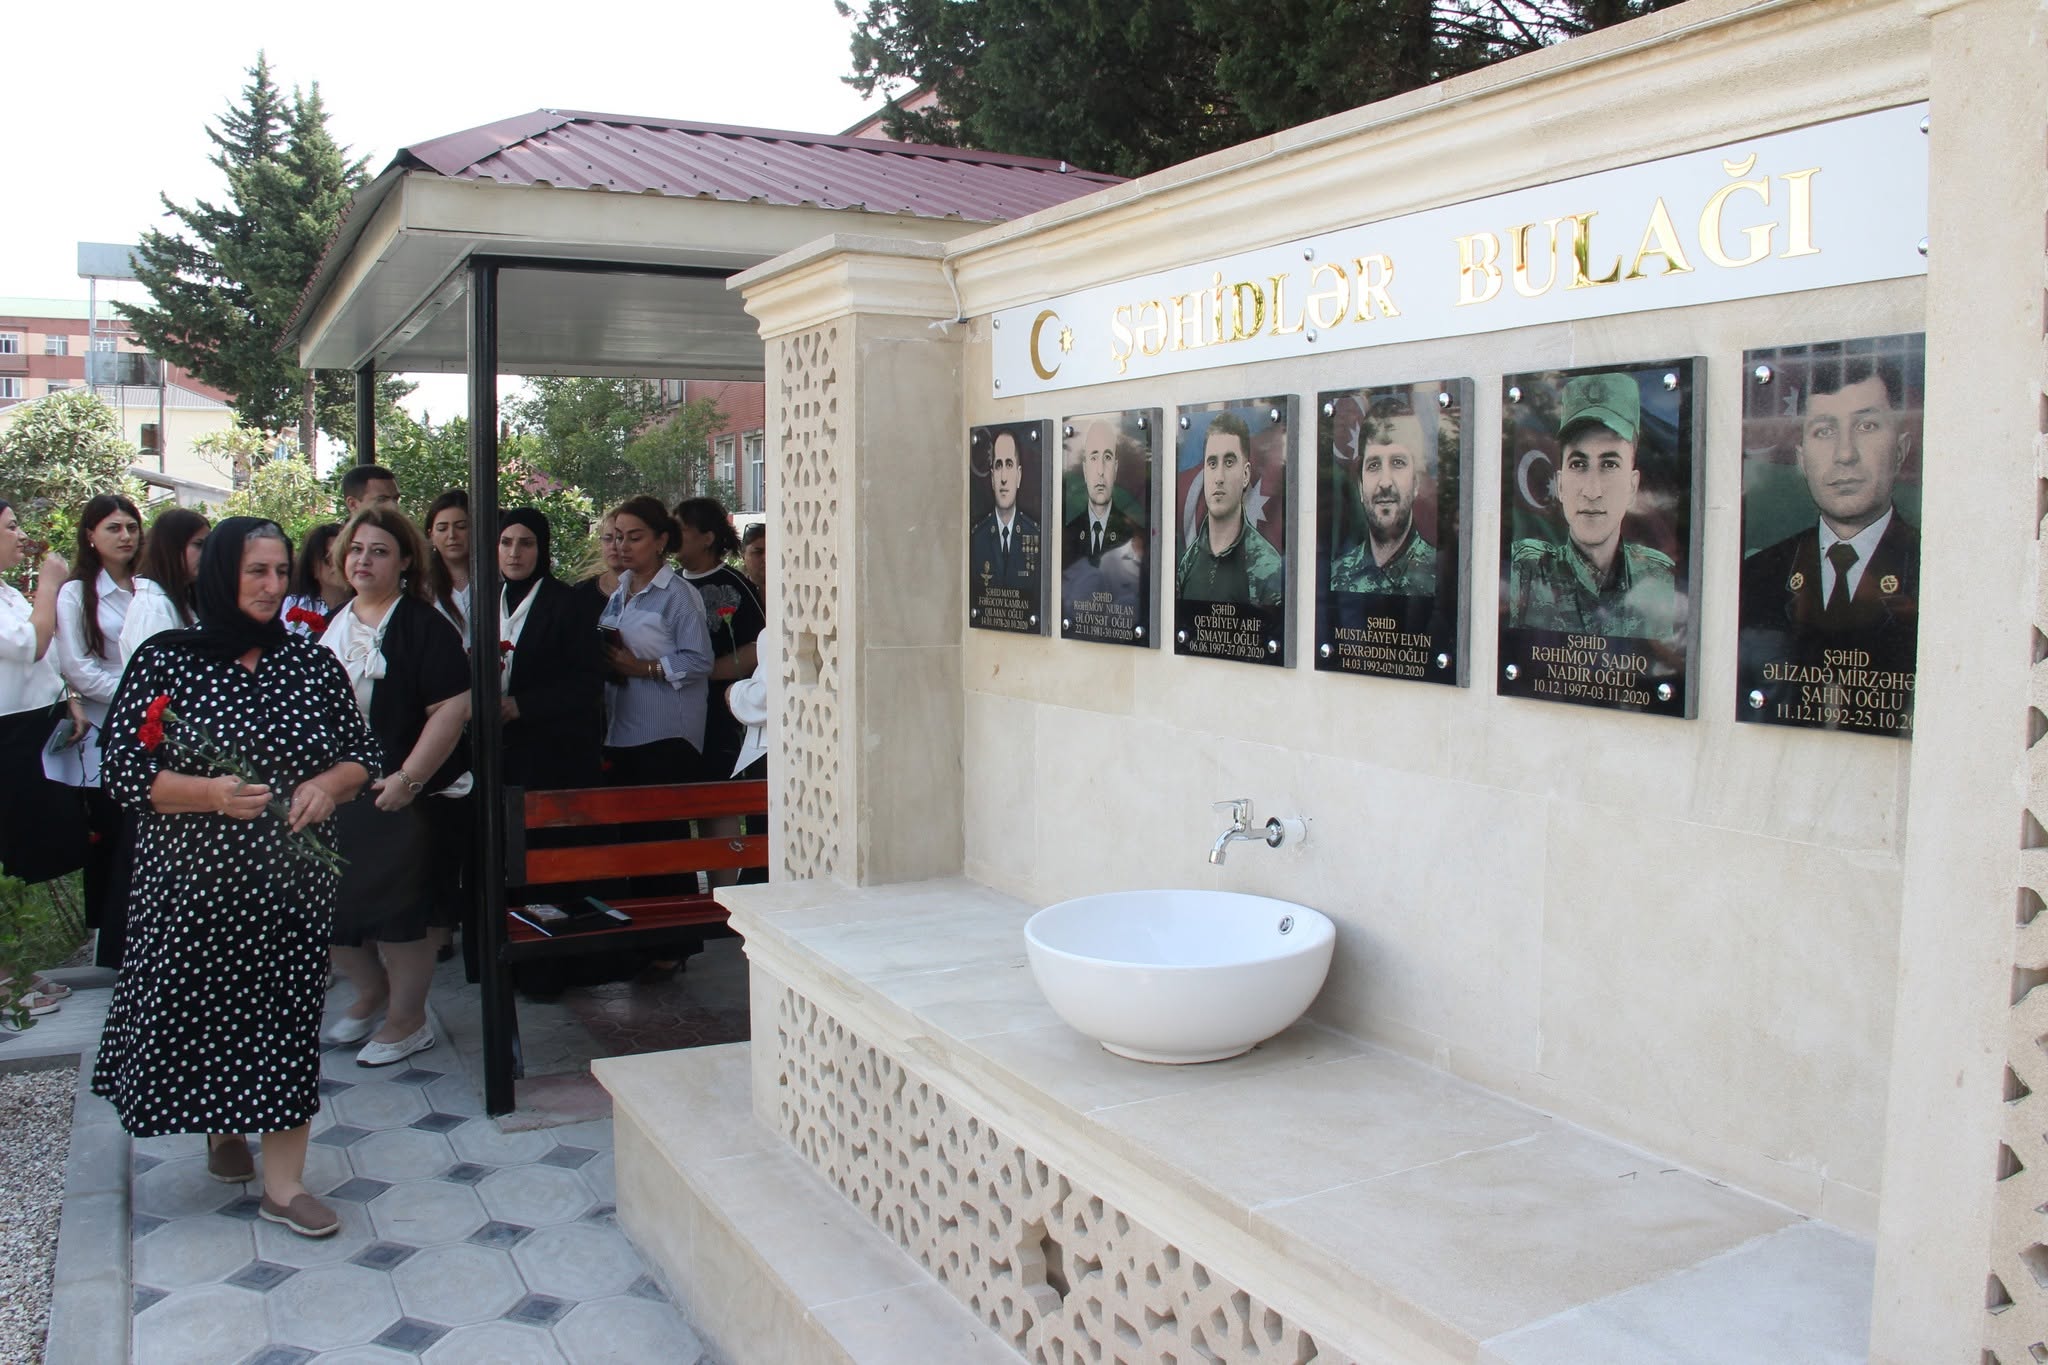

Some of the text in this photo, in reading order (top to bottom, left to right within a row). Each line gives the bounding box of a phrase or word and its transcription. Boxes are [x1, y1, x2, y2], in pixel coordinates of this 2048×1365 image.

[1111, 153, 1822, 374] ŞƏHİDLƏR BULAĞI
[1004, 598, 1029, 609] KAMRAN
[1106, 604, 1134, 616] NURLAN
[1211, 603, 1236, 616] ŞƏHİD
[1111, 616, 1133, 629] OĞLU
[1194, 614, 1262, 632] QEYBİYEV ARİF
[1367, 616, 1396, 630] ŞƏHİD
[1233, 630, 1260, 647] OĞLU
[1334, 627, 1432, 648] MUSTAFAYEV ELVİN
[1567, 634, 1607, 651] ŞƏHİD
[1189, 641, 1265, 658] 06.06.1997-27.09.2020
[1338, 643, 1428, 664] FƏXRƏDDİN OĞLU
[1823, 648, 1870, 668] ŞƏHİD
[1342, 658, 1425, 677] 14.03.1992-02.10.2020
[1532, 646, 1648, 675] RƏHİMOV SADİQ
[1547, 663, 1636, 688] NADİR OĞLU
[1763, 661, 1834, 685] ƏLİZADƏ
[1533, 679, 1650, 705] 10.12.1997-03.11.2020
[1802, 684, 1903, 710] ŞAHİN OĞLU
